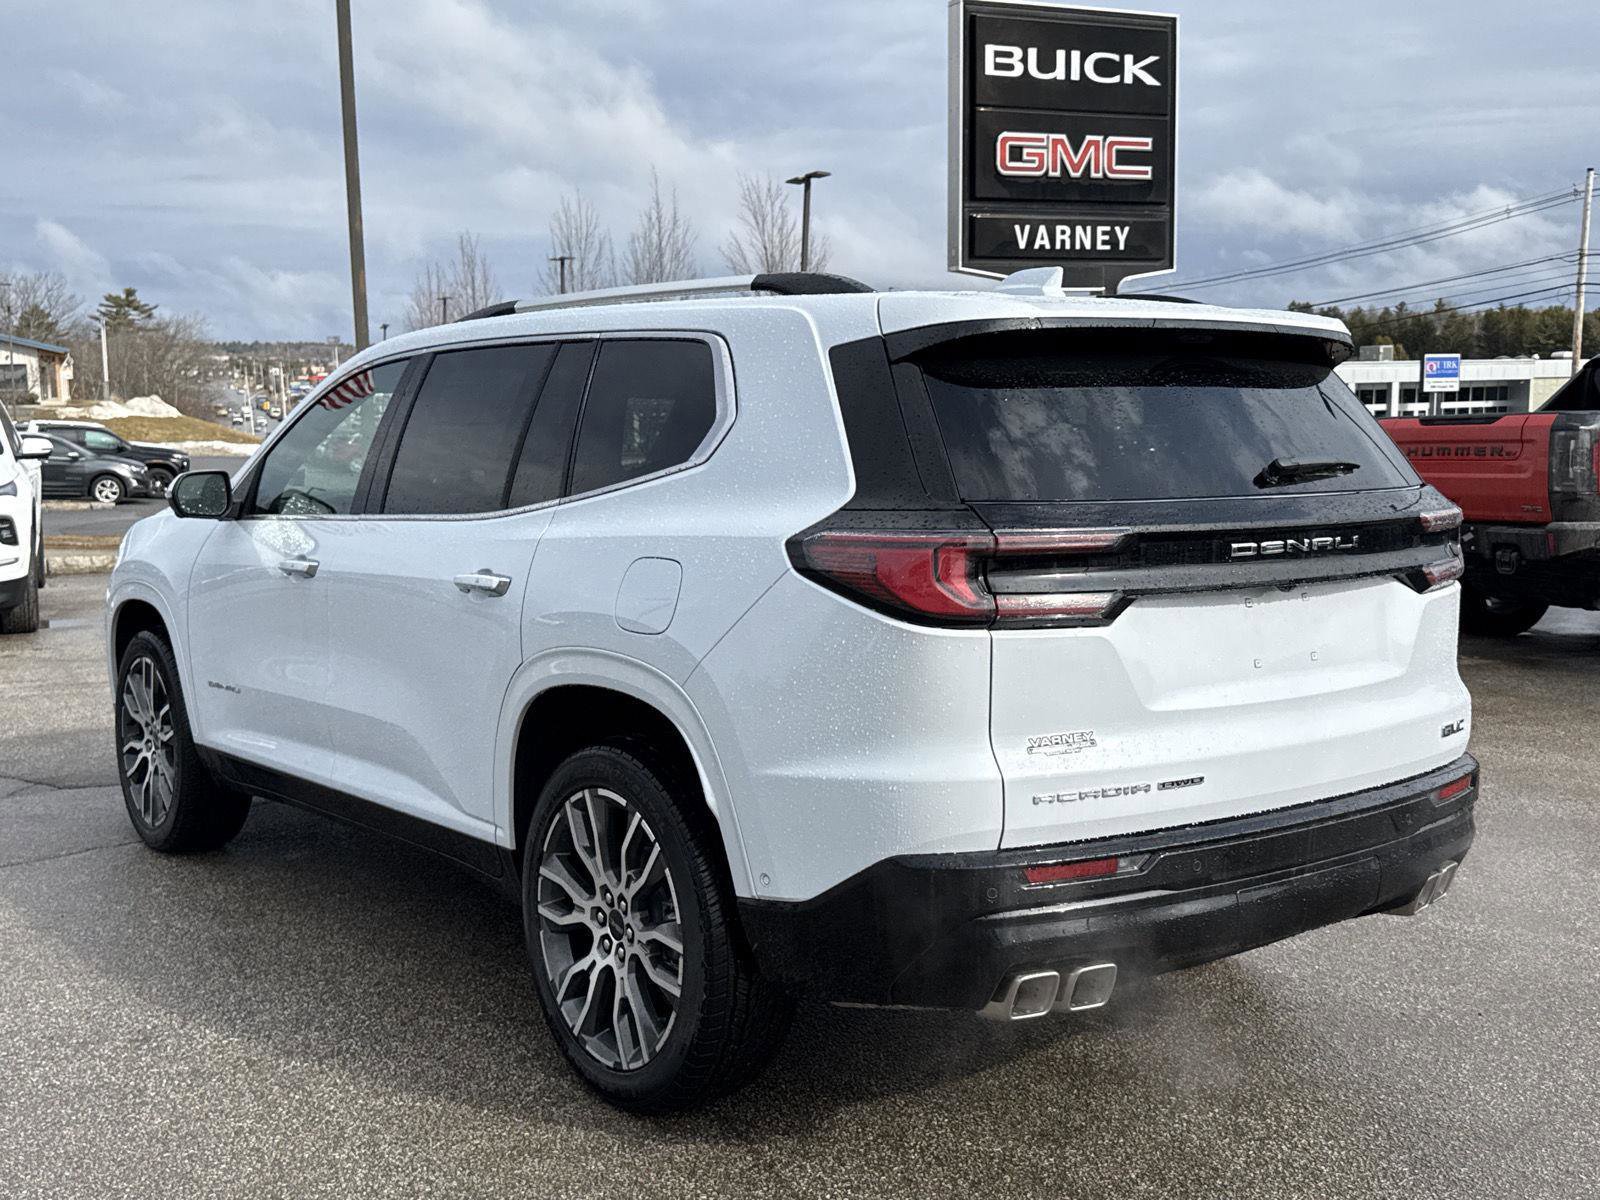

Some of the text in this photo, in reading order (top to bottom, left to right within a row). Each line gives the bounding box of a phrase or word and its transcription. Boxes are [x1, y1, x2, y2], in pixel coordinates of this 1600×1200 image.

[984, 43, 1162, 87] BUICK
[997, 131, 1153, 181] GMC
[1013, 224, 1131, 251] VARNEY
[1407, 445, 1504, 457] HUMMER
[1230, 534, 1359, 557] DENALI
[1027, 730, 1094, 748] VARNEY
[1032, 782, 1151, 806] ACADIA
